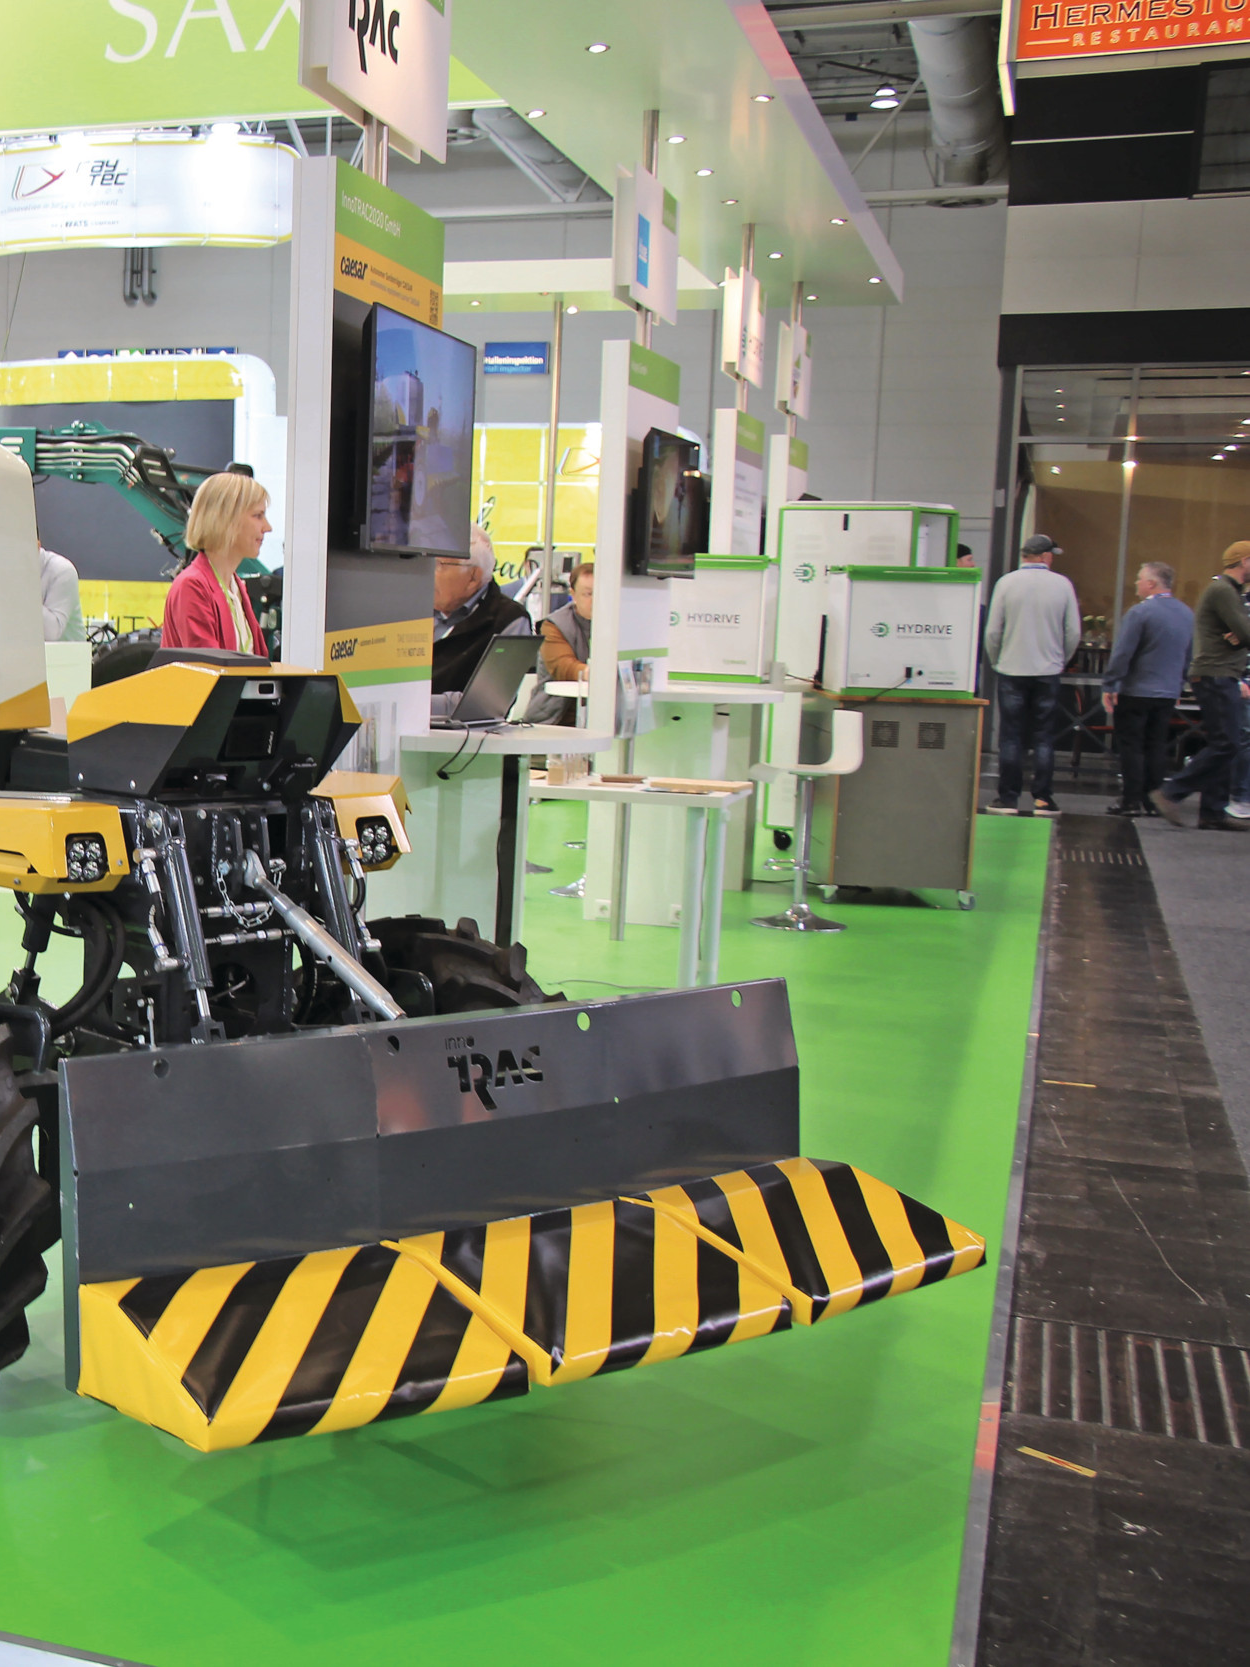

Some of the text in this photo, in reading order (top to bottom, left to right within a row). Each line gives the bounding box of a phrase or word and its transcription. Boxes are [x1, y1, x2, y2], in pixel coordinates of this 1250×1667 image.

[1072, 17, 1250, 47] RESTAURAN
[340, 255, 369, 281] caesar
[687, 613, 741, 624] HYDRIVE
[896, 624, 953, 635] HYDRIVE
[330, 637, 358, 662] caesar
[447, 1045, 544, 1112] TRAC
